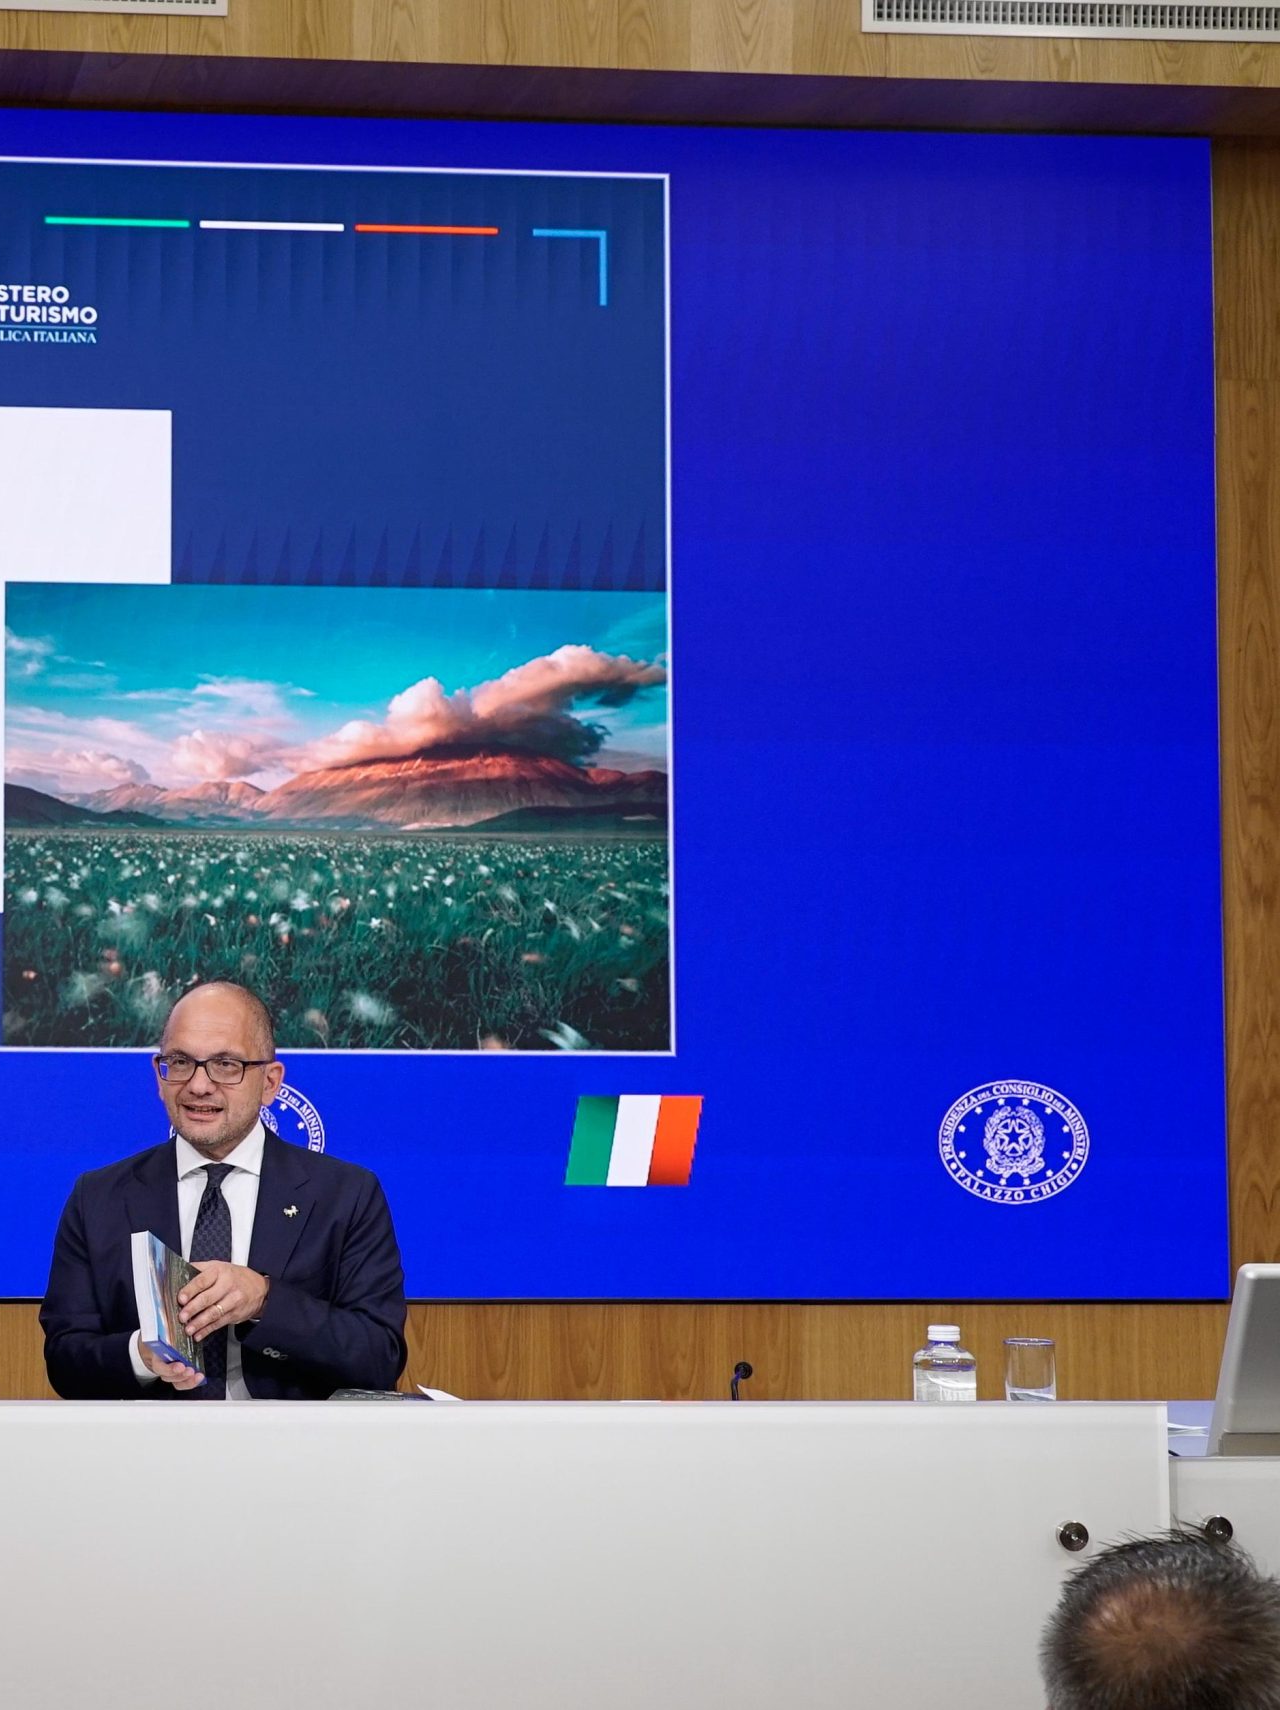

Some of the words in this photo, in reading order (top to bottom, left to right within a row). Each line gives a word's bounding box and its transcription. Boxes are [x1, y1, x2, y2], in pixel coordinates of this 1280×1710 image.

[33, 330, 97, 344] ITALIANA
[299, 1103, 321, 1153] MINISTR
[942, 1096, 978, 1160] PRESIDENZA
[992, 1084, 1054, 1102] CONSIGLIO
[1064, 1108, 1086, 1161] MINISTRI
[955, 1169, 1024, 1200] PALAZZO
[1030, 1171, 1074, 1198] CHIGI
